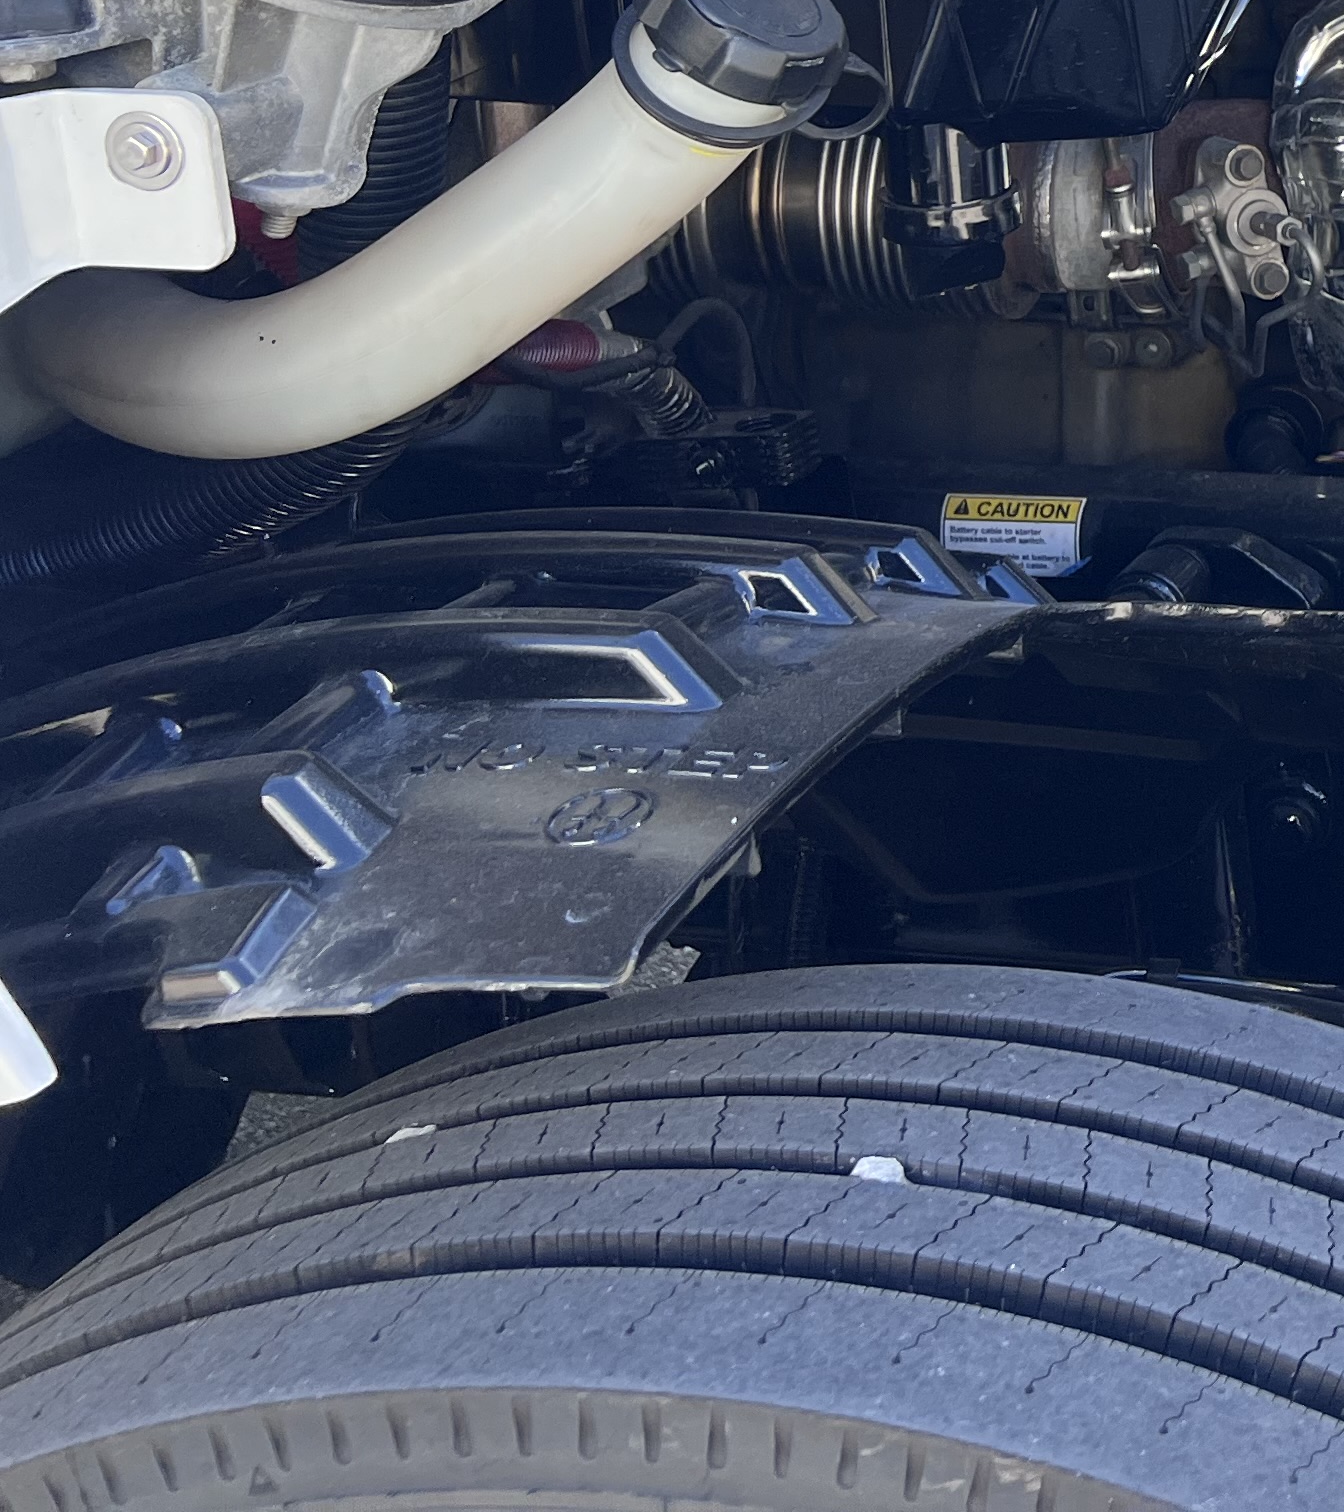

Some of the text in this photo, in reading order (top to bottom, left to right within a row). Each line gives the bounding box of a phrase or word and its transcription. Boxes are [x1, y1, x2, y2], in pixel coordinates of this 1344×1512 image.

[977, 501, 1072, 519] CAUTION
[949, 526, 978, 535] Battery
[981, 526, 1002, 534] cable
[1004, 527, 1013, 535] to
[949, 536, 1046, 544] bypasses cut-off switch.
[1031, 554, 1059, 563] battery
[1061, 555, 1071, 563] to
[564, 742, 791, 780] STEP
